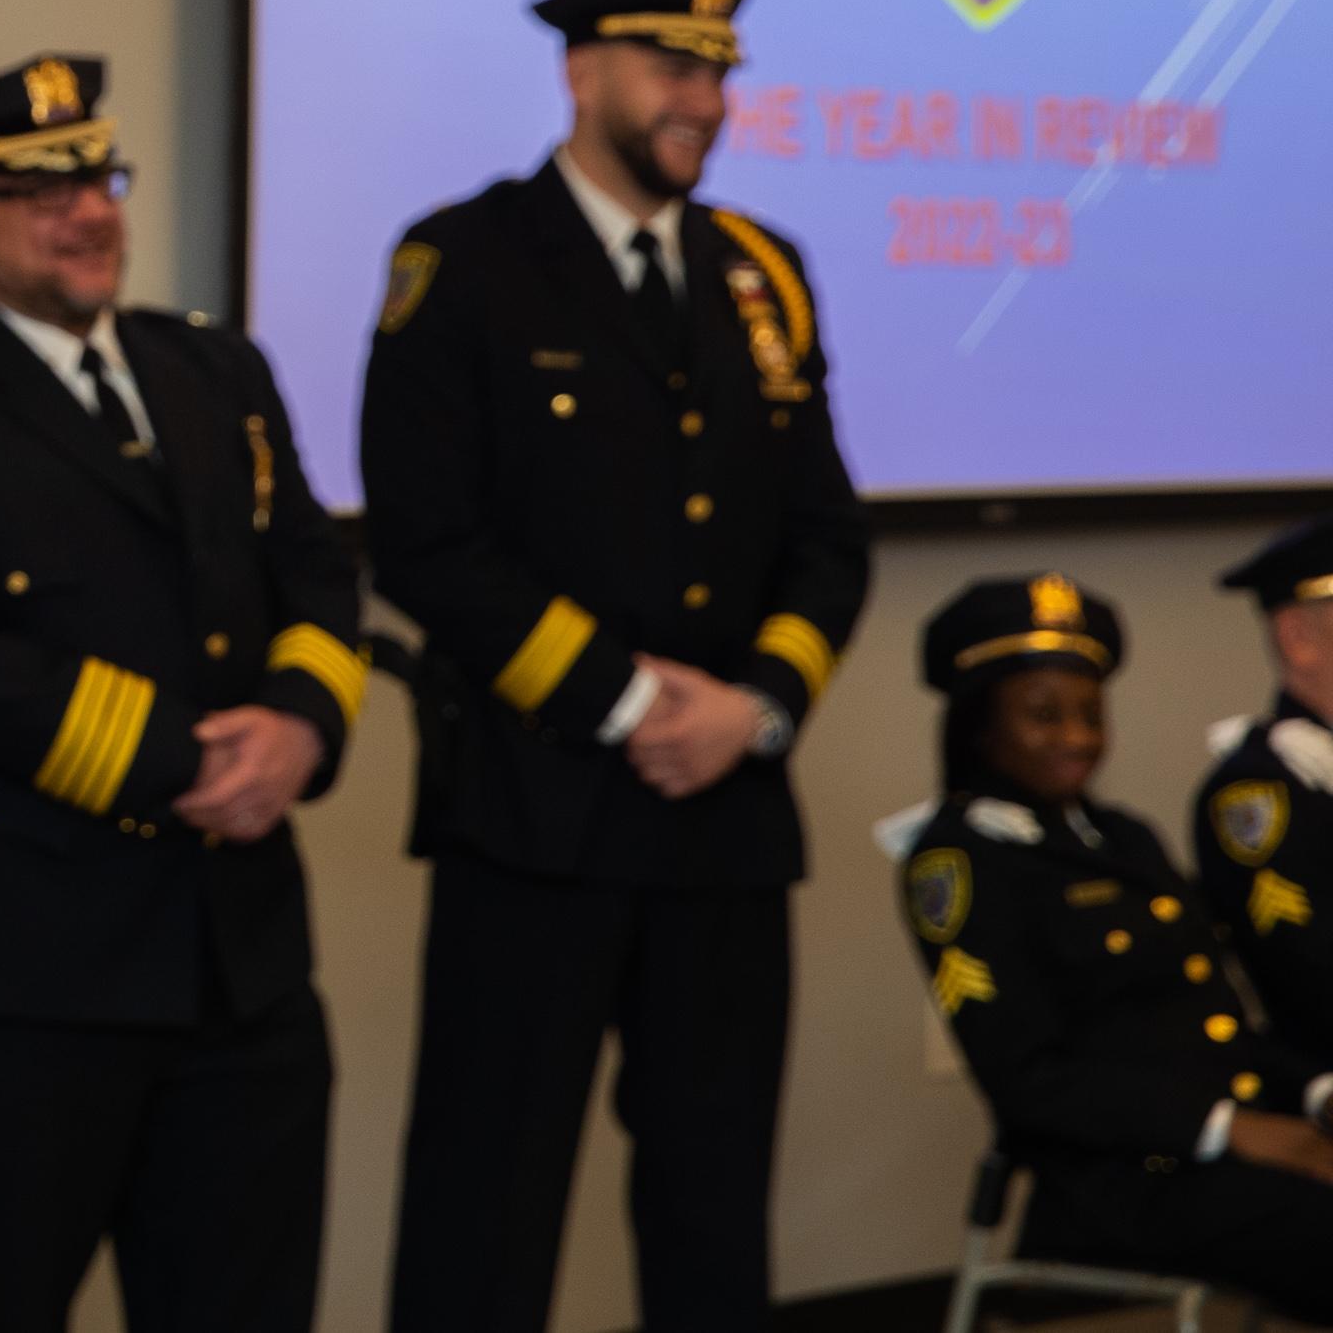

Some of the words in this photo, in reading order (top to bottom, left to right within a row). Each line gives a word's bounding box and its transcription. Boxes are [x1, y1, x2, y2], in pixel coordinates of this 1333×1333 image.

[727, 82, 806, 161] HE
[817, 84, 959, 162] YEAR
[970, 92, 1027, 164] IN
[1035, 92, 1226, 170] REVIEW
[885, 193, 1074, 269] 2022-23
